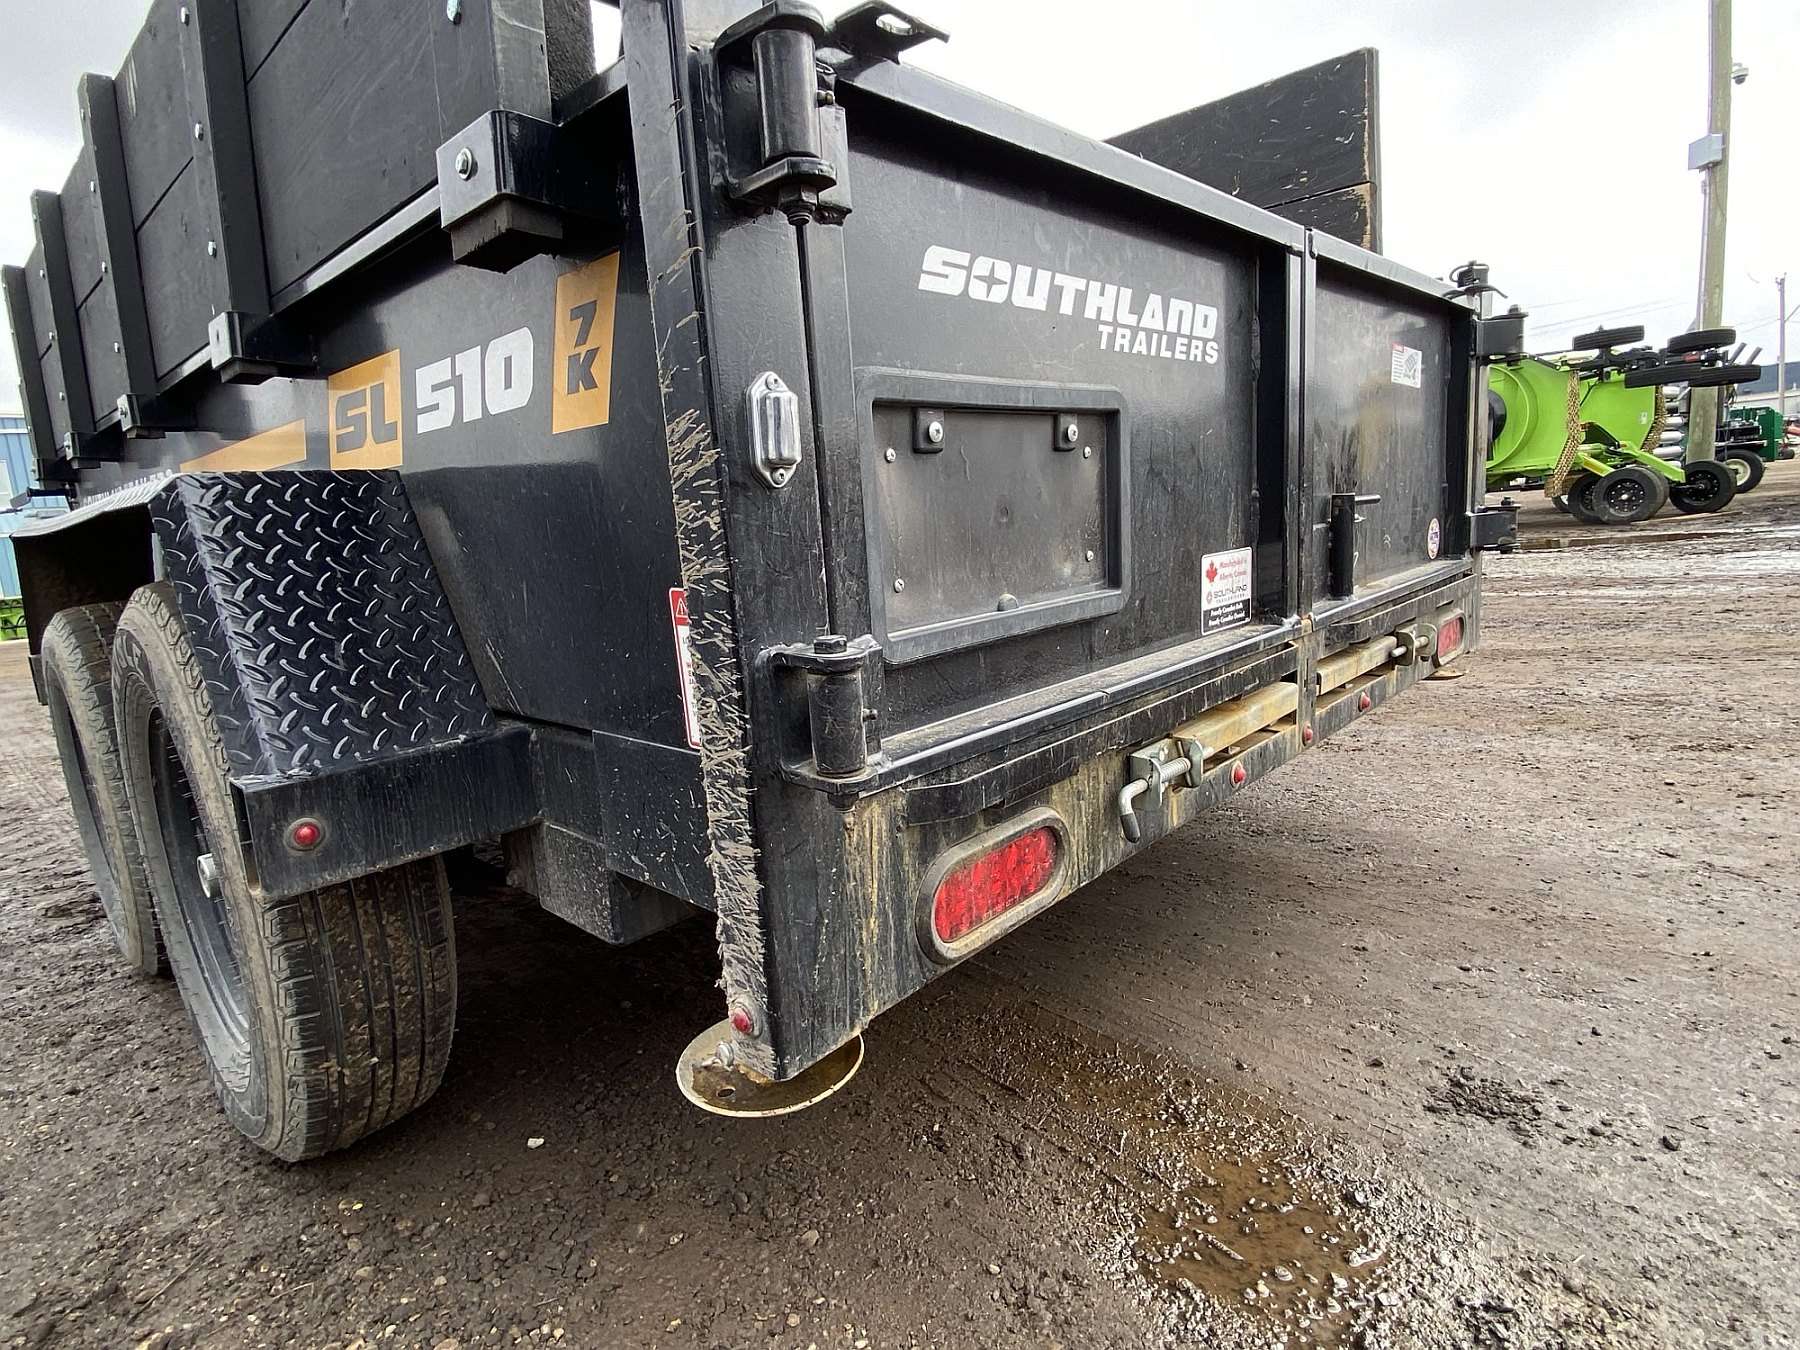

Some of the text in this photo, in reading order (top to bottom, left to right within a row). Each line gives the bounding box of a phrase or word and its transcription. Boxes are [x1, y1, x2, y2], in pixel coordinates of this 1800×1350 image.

[918, 245, 1218, 339] SOUTHLAND
[570, 300, 597, 349] 7
[1098, 324, 1219, 365] TRAILERS
[335, 327, 534, 453] SL 510
[567, 347, 599, 395] K
